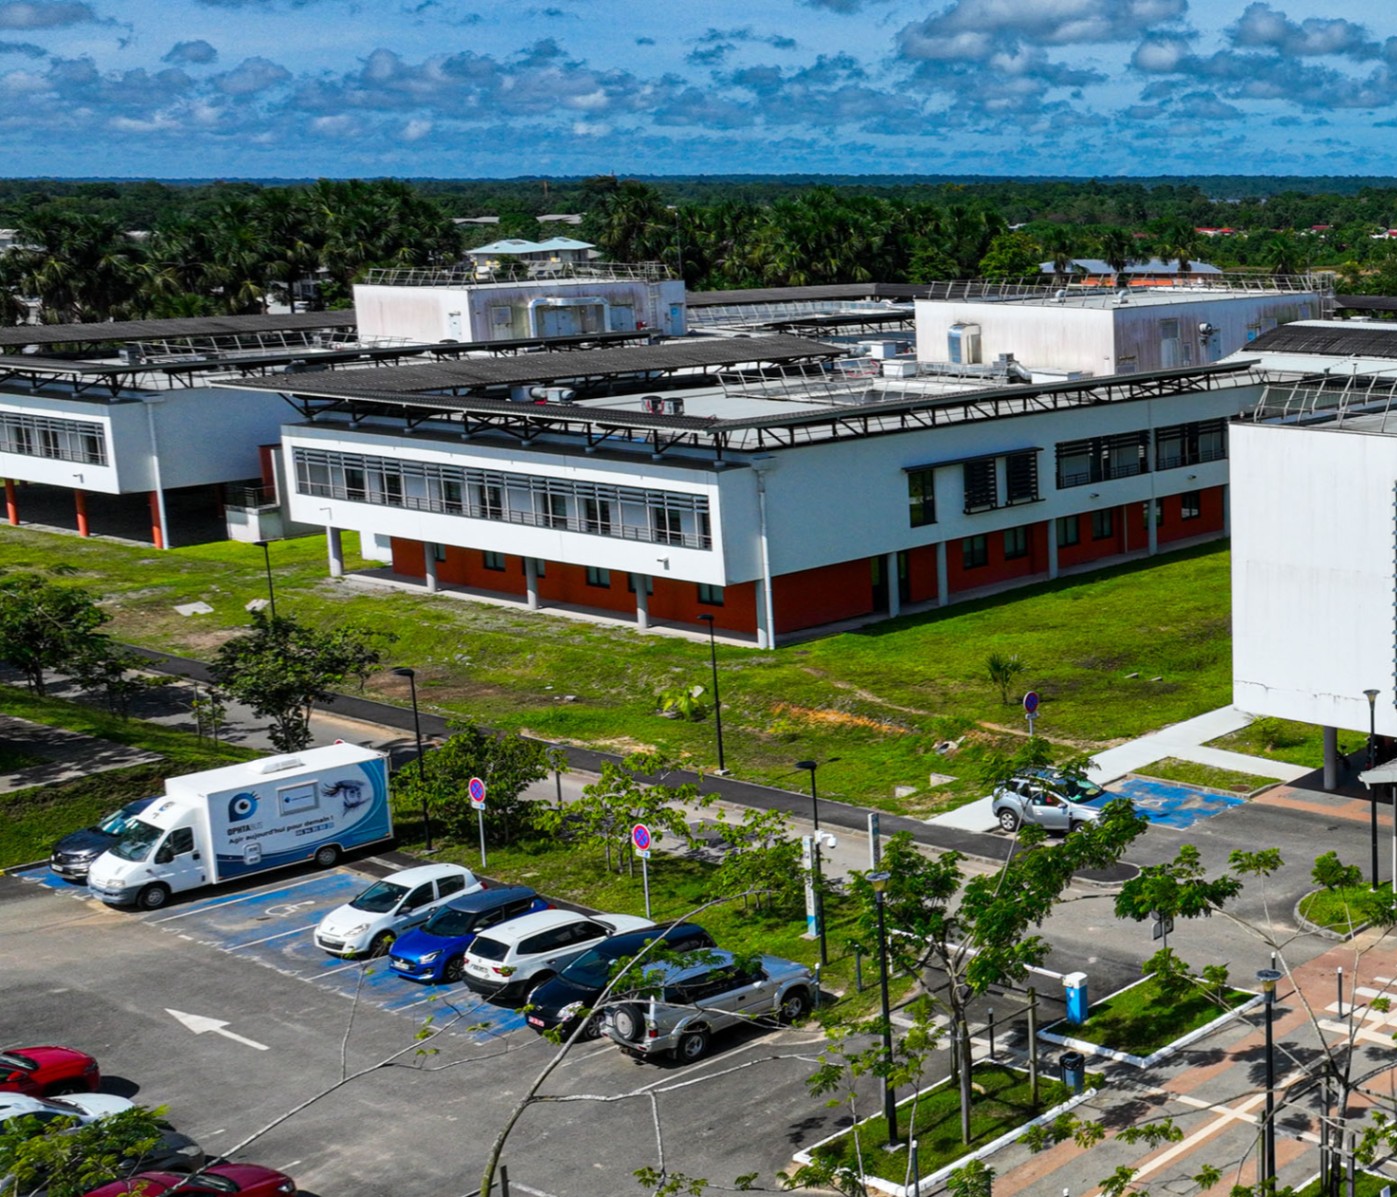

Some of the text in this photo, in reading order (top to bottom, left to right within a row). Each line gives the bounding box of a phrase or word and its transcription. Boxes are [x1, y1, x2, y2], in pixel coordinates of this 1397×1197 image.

[228, 836, 244, 845] Agir
[286, 821, 303, 833] pour
[304, 815, 330, 828] demain
